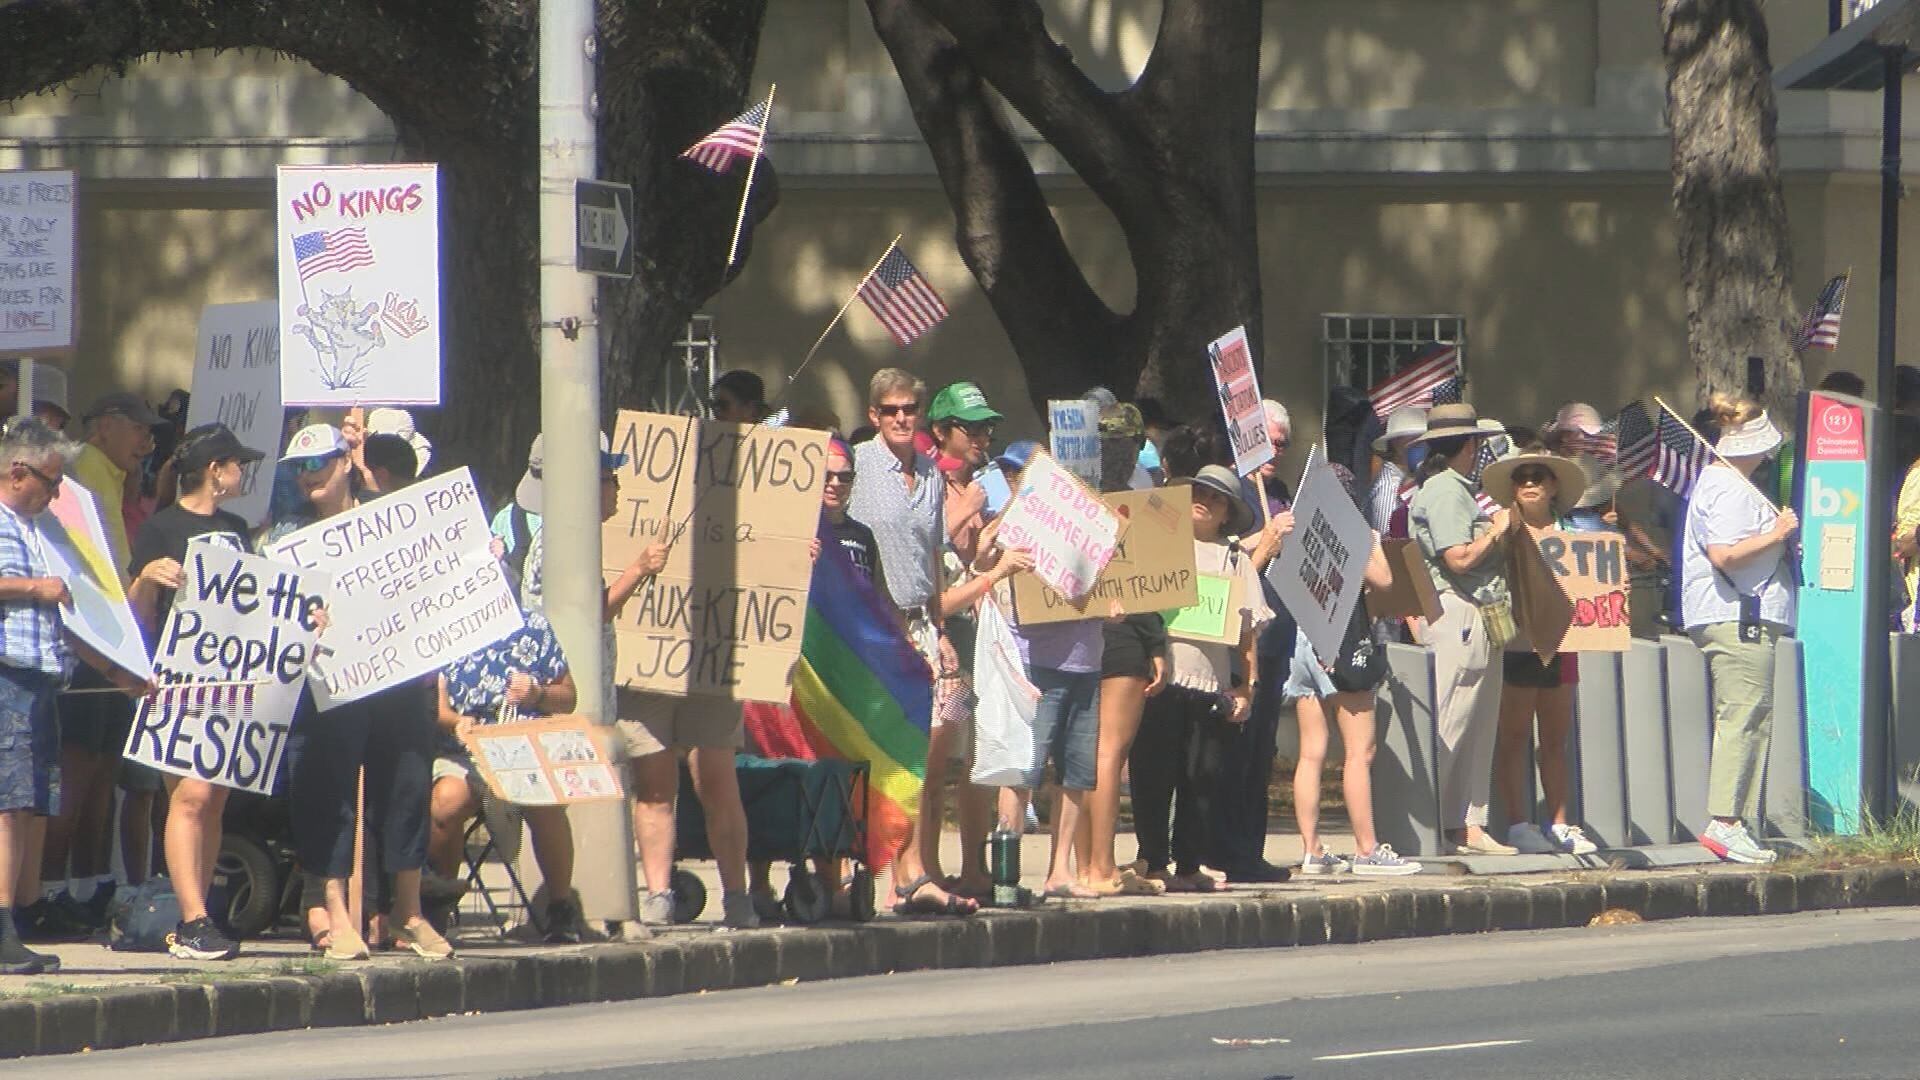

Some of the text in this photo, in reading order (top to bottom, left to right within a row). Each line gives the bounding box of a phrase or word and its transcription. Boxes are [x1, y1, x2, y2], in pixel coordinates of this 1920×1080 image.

[291, 181, 423, 221] NO KINGS
[208, 333, 232, 370] NO
[619, 422, 824, 493] NO KINGS
[1049, 471, 1073, 500] TO
[278, 481, 474, 568] I STAND FOR:
[445, 518, 468, 543] OF
[703, 516, 723, 543] is
[734, 523, 756, 543] a
[195, 553, 325, 632] We the
[380, 552, 461, 600] SPEECH
[1127, 568, 1190, 600] TRUMP
[366, 560, 499, 646] DUE PROCESS
[616, 584, 796, 643] AUX-KING
[1573, 590, 1630, 628] DER
[166, 609, 305, 684] People
[323, 646, 405, 697] UNDER
[637, 635, 749, 686] JOKE
[128, 697, 289, 791] RESIST
